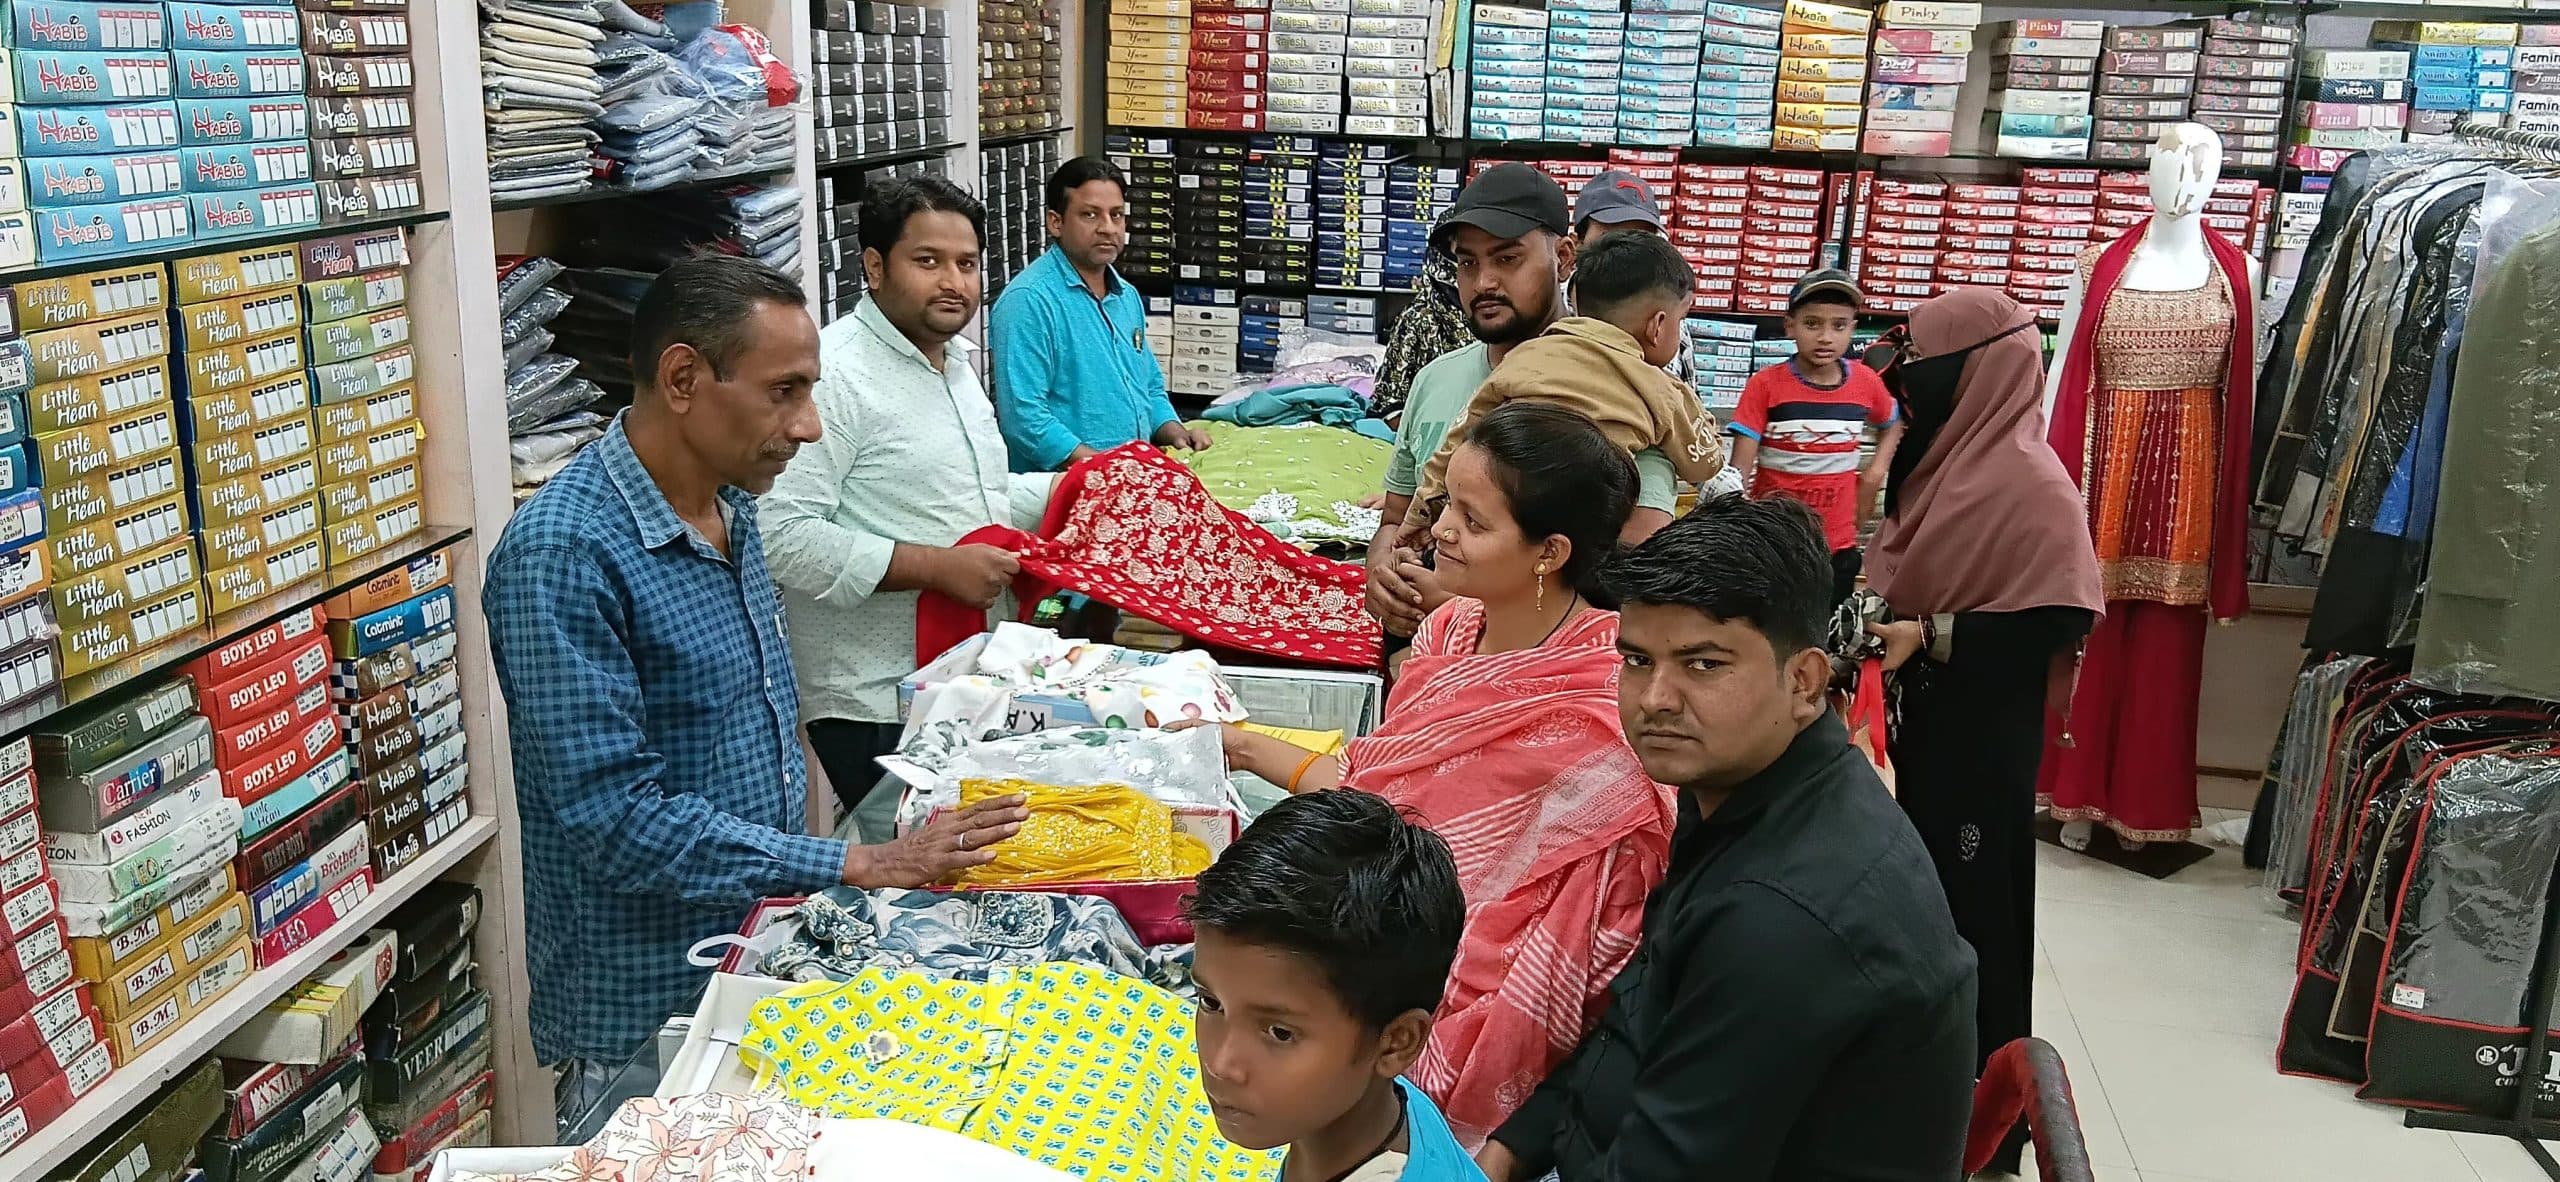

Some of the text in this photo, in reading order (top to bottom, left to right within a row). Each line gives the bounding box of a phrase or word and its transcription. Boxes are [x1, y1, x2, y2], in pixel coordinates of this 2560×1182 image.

[1900, 6, 1940, 20] Pinky
[2029, 21, 2060, 35] Pinky
[311, 241, 341, 263] Little
[187, 261, 222, 282] Little
[202, 274, 239, 296] Heart
[27, 279, 70, 308] Little
[322, 281, 346, 301] Little
[44, 300, 89, 324] Heart
[195, 305, 227, 330] Little
[208, 321, 242, 344] Heart
[326, 323, 352, 344] Little
[40, 334, 80, 362] Little
[58, 351, 99, 378] Heart
[198, 350, 231, 376] Little
[331, 362, 356, 383] Little
[211, 365, 245, 389] Heart
[41, 383, 80, 412] Little
[204, 396, 237, 421] Little
[57, 399, 98, 426] Heart
[218, 408, 251, 433] Heart
[326, 403, 354, 427] Little
[53, 431, 91, 462] Little
[206, 437, 239, 464] Little
[327, 442, 355, 465] Little
[69, 447, 109, 476] Heart
[219, 451, 253, 476] Heart
[51, 480, 90, 510] Little
[212, 479, 246, 507] Little
[331, 482, 357, 506] Little
[67, 496, 107, 524] Heart
[226, 495, 261, 519] Heart
[56, 528, 96, 560] Little
[215, 523, 247, 550] Little
[336, 521, 363, 546] Little
[72, 542, 114, 572] Heart
[227, 536, 261, 562] Heart
[65, 575, 106, 607] Little
[219, 565, 252, 593] Little
[232, 578, 266, 603] Heart
[366, 573, 401, 595] Catmint
[81, 589, 124, 620] Heart
[72, 621, 112, 652] Little
[364, 615, 404, 638] Catmint
[88, 634, 129, 665] Heart
[219, 628, 278, 667] BOYS LEO
[228, 670, 288, 710] BOYS LEO
[74, 712, 129, 749] TWINS
[236, 710, 290, 750] BOYS LEO
[243, 749, 297, 792] BOYS LEO
[103, 763, 158, 807] Carrier
[126, 809, 172, 842] FASHION
[130, 857, 159, 888] LEO
[320, 841, 365, 878] Brother's
[116, 917, 154, 952] B.M.
[131, 957, 169, 992] B.M.
[136, 1001, 175, 1037] B.M.
[403, 1036, 445, 1082] VEER
